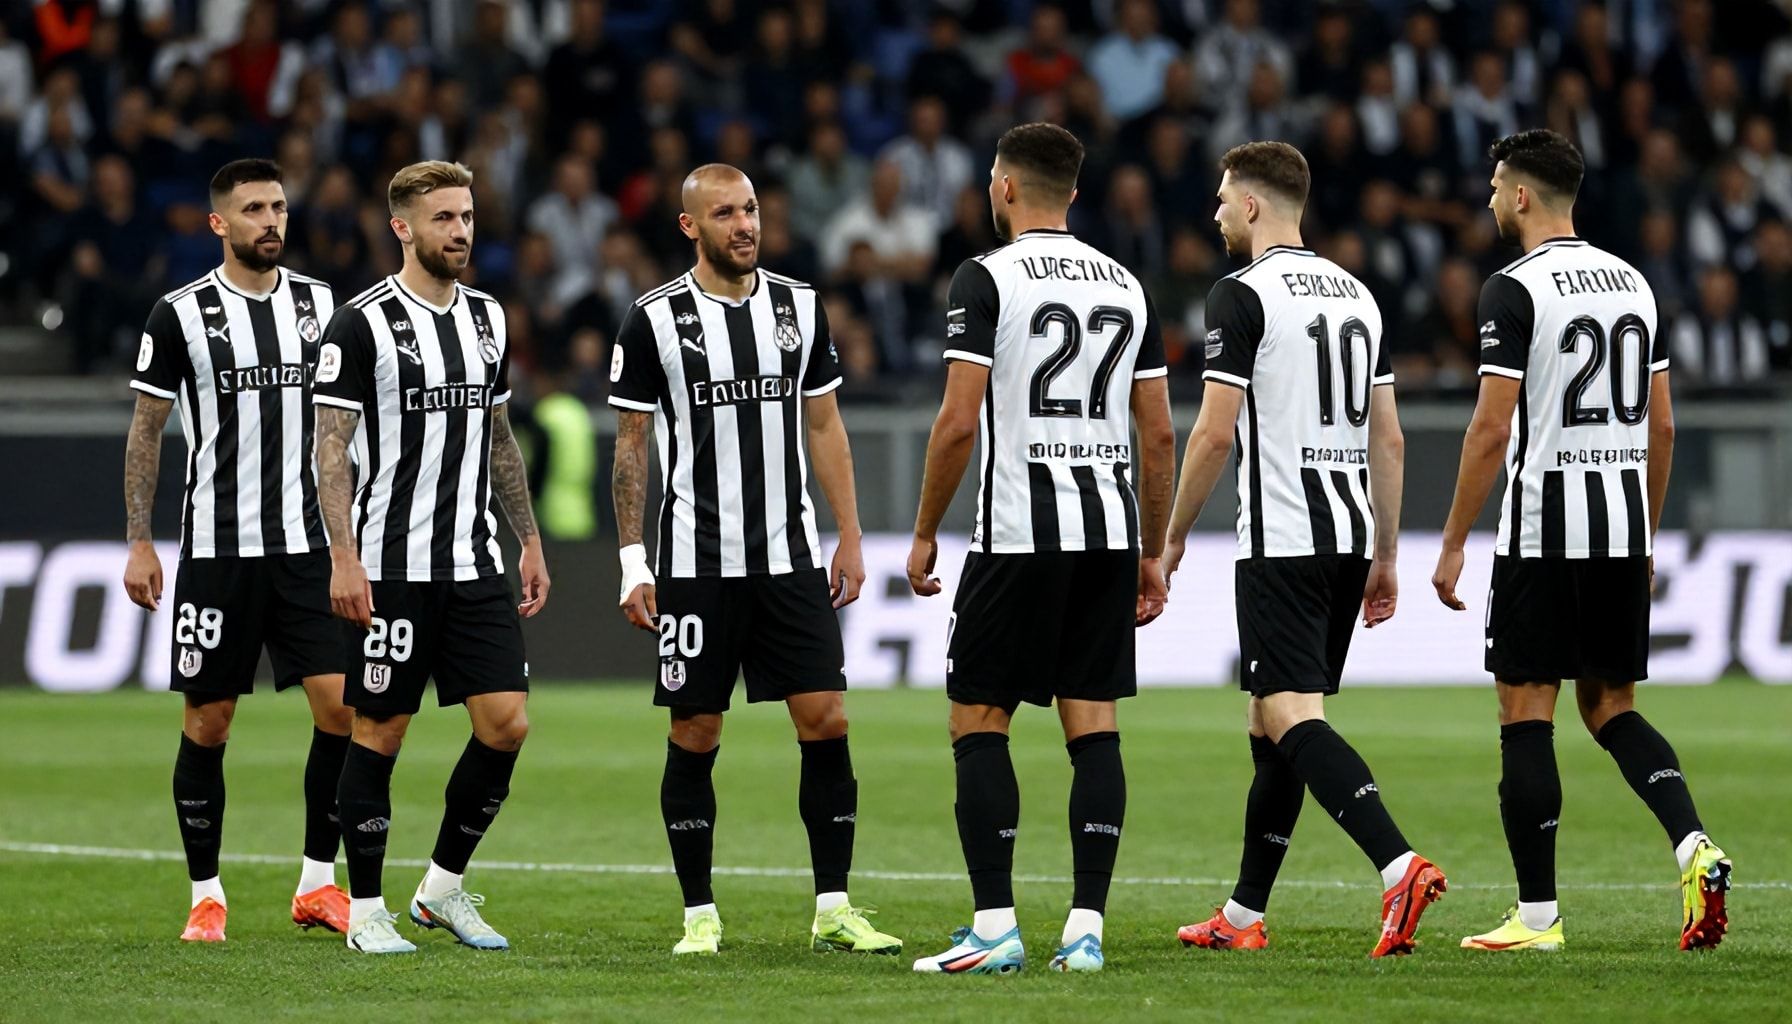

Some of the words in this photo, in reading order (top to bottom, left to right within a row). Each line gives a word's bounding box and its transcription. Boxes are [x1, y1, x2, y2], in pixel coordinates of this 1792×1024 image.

[1029, 301, 1134, 419] 27
[1305, 313, 1373, 427] 10
[1559, 313, 1651, 427] 20
[364, 617, 413, 662] 29
[659, 614, 703, 658] 20
